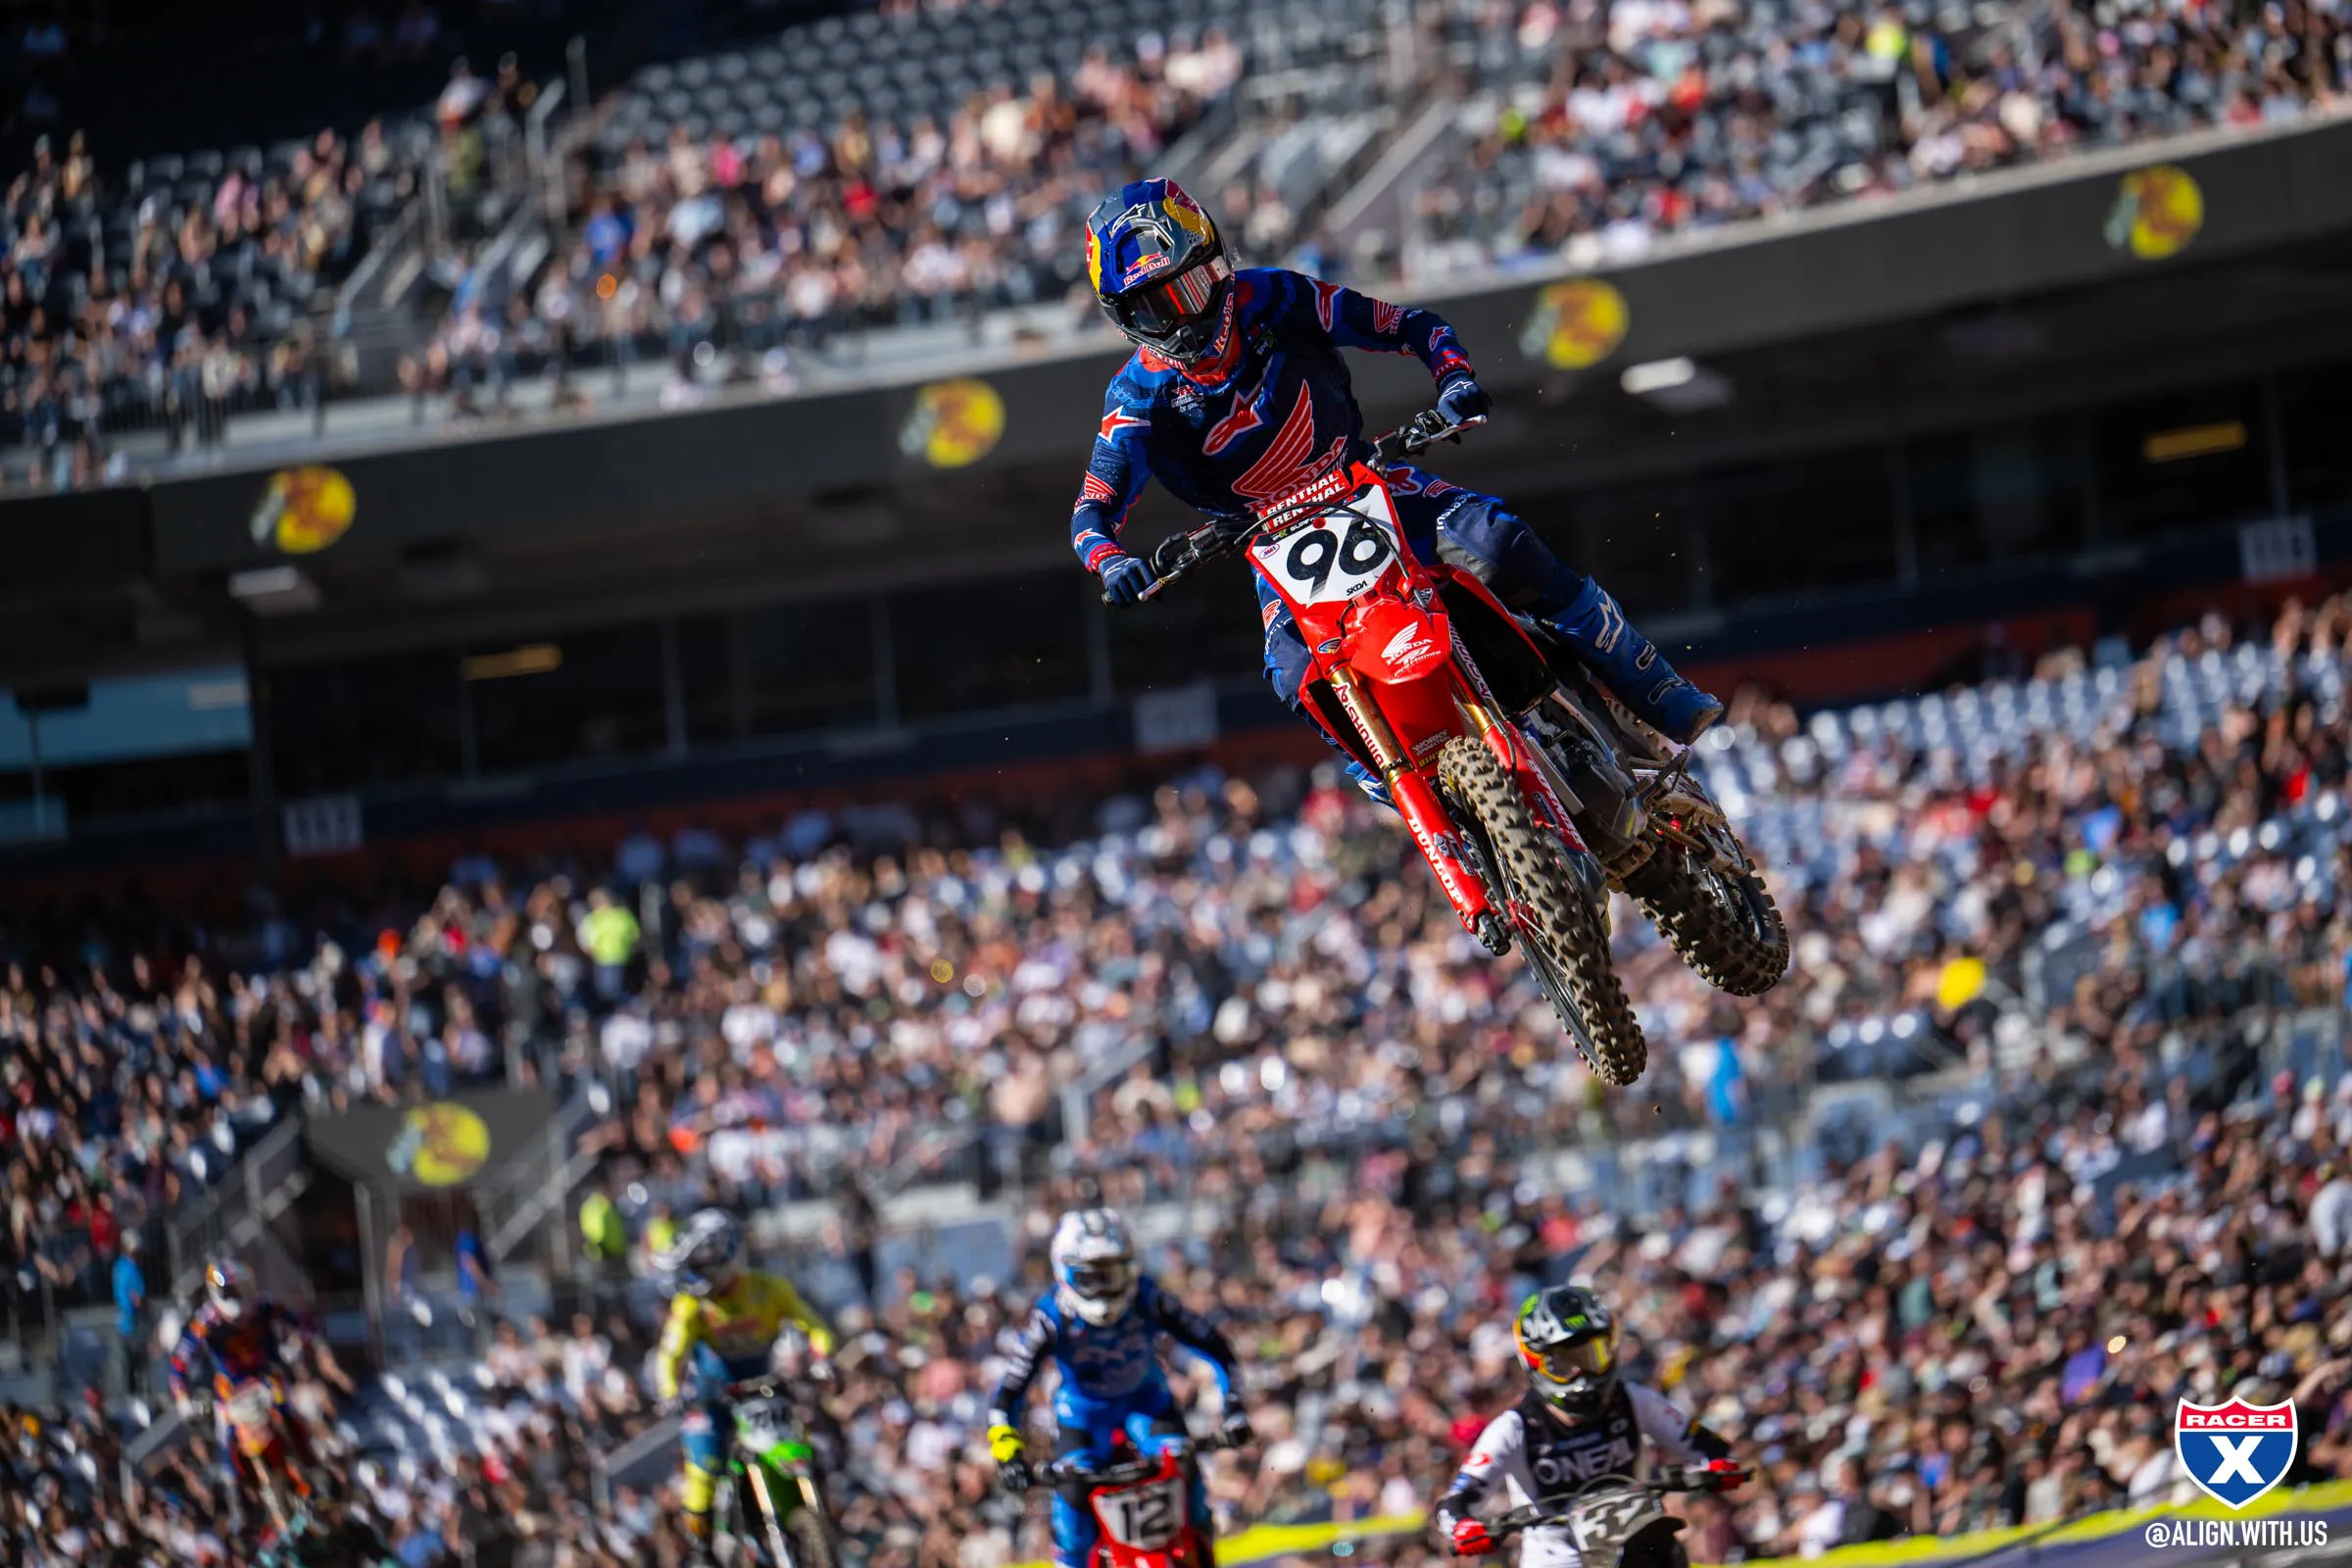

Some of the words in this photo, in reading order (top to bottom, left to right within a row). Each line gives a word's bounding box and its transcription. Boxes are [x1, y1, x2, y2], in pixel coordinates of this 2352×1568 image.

[1124, 266, 1146, 286] Red
[1146, 257, 1170, 274] Bull
[1266, 473, 1340, 515] RENTHAL
[1287, 510, 1392, 599] 96
[1347, 580, 1368, 596] SKDA
[1386, 639, 1434, 665] HONDA
[1408, 817, 1464, 905] DUNLOP
[1119, 1494, 1174, 1544] 12
